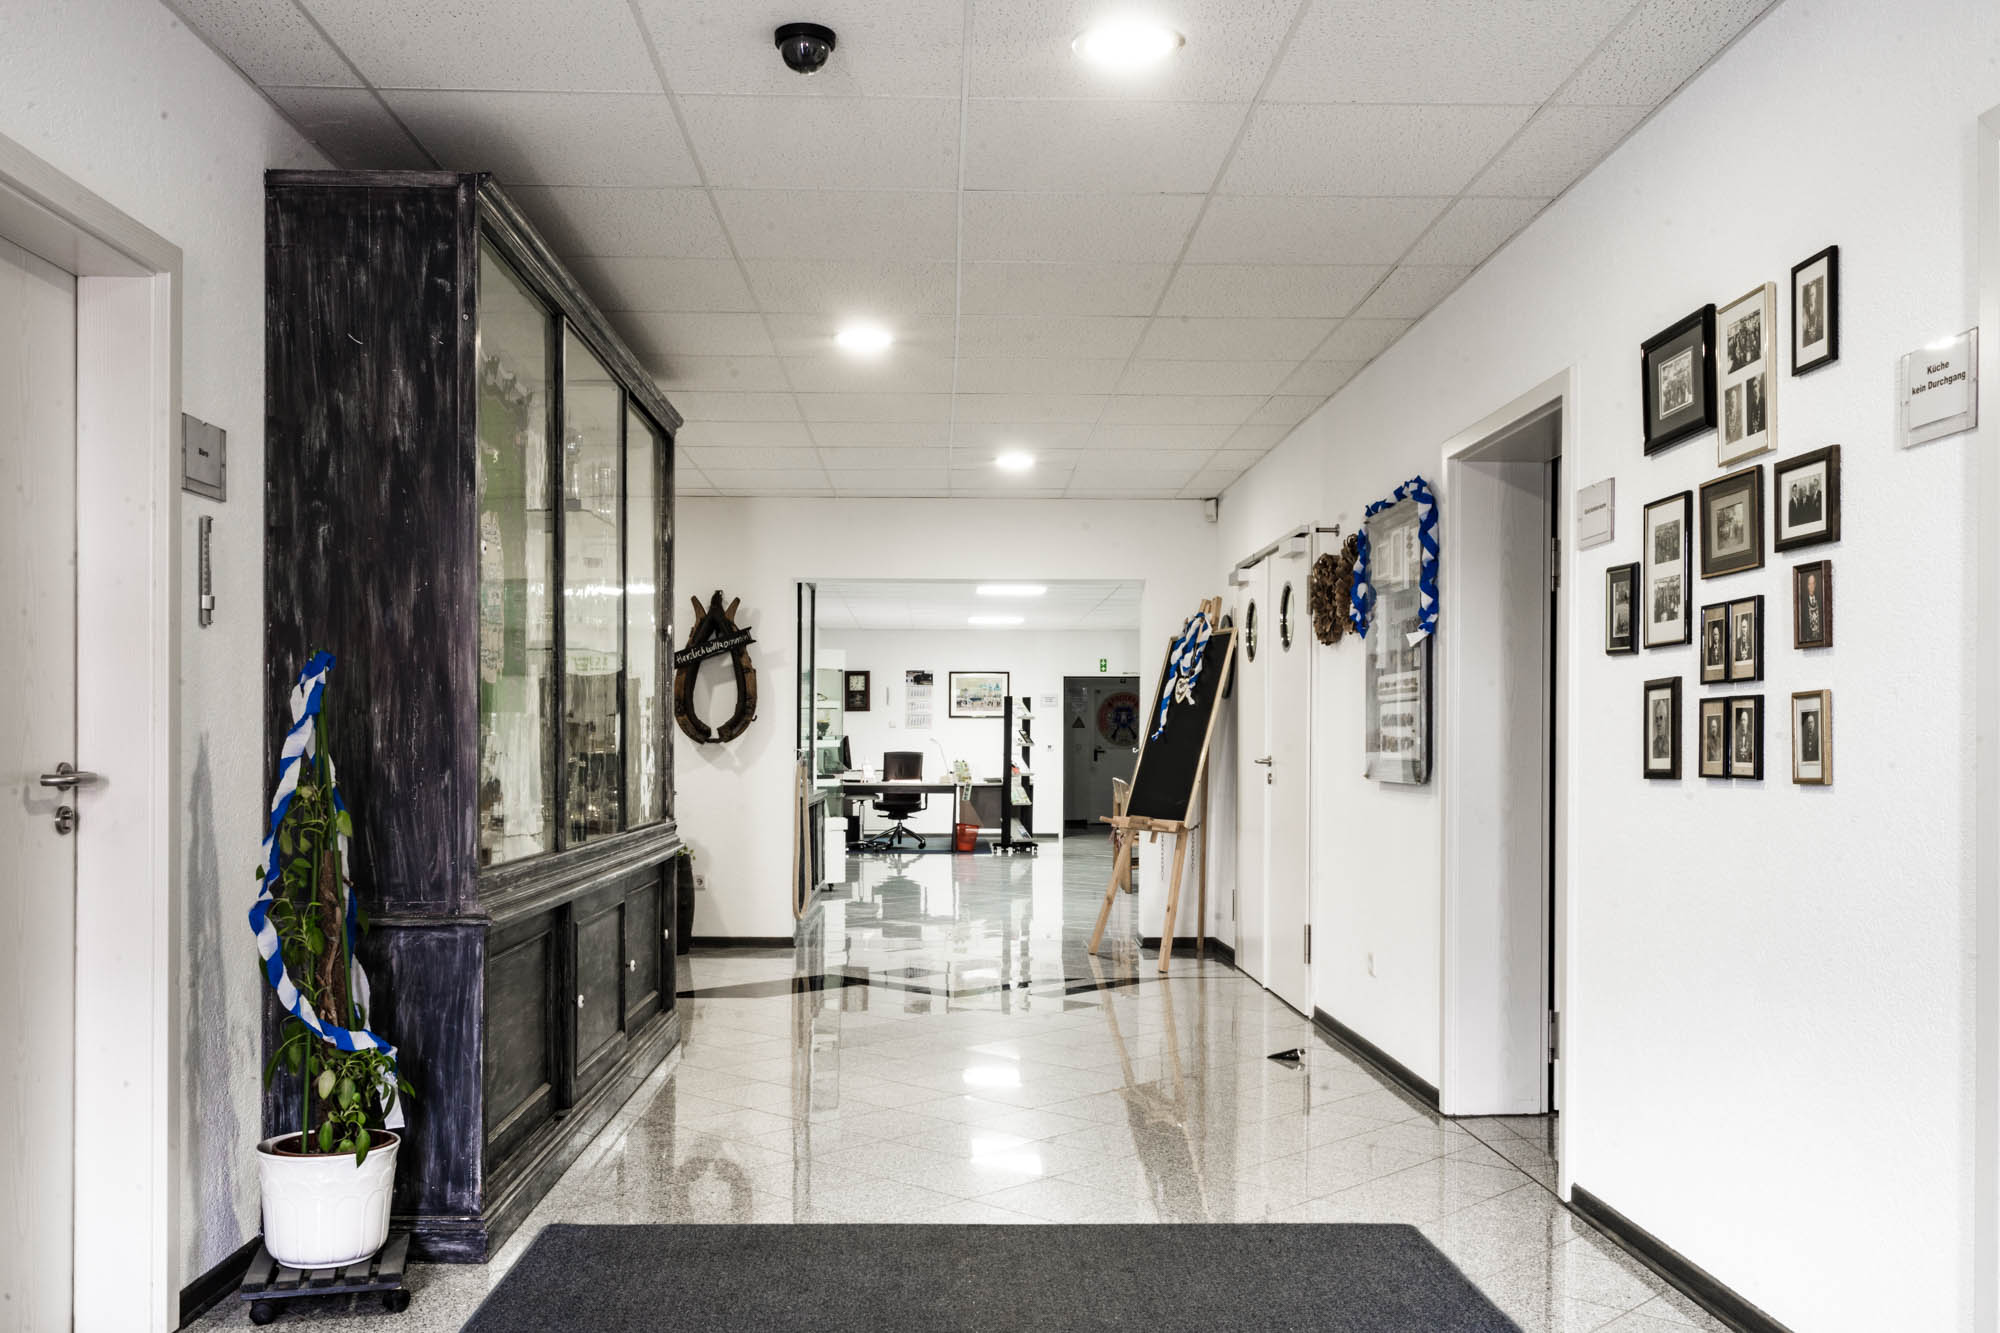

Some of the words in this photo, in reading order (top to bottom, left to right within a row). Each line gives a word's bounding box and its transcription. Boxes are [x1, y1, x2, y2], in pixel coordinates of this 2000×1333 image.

[1926, 361, 1949, 375] Küche
[1911, 384, 1926, 395] kein
[1927, 371, 1966, 390] Durchgang
